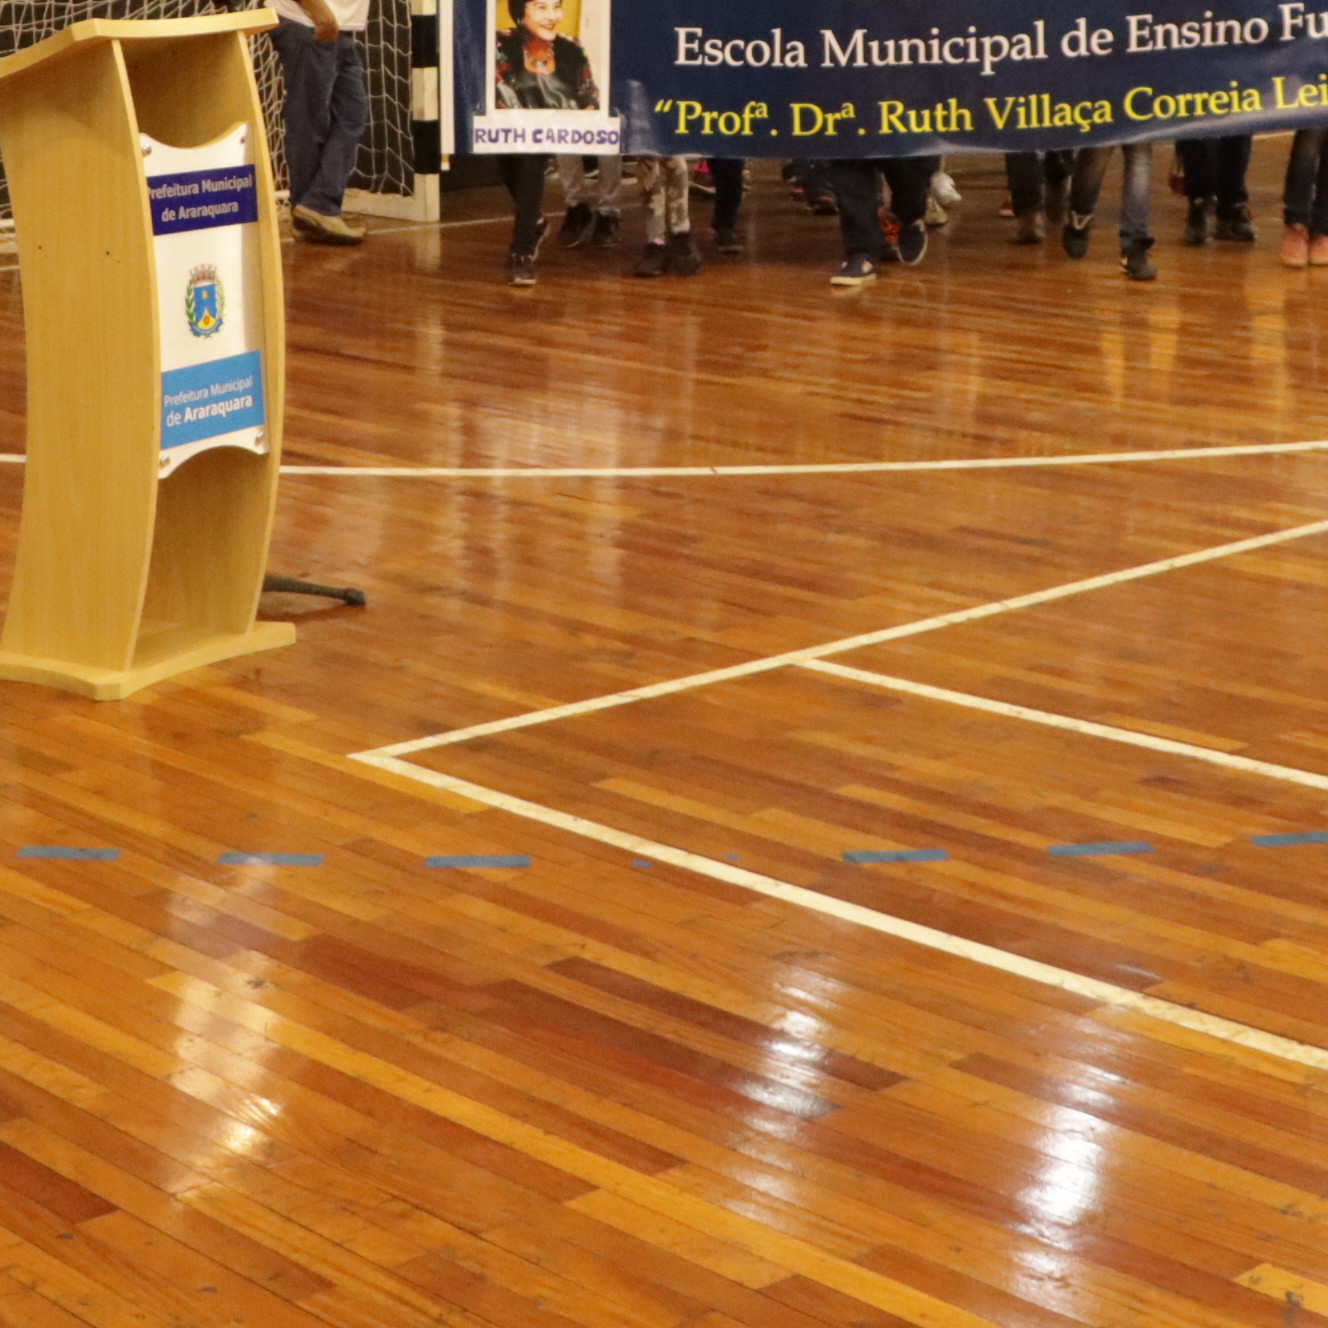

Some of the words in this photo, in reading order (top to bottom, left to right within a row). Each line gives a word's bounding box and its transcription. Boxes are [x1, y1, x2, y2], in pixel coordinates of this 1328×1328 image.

[674, 26, 808, 68] Escola
[820, 20, 1049, 76] Municipal
[1060, 17, 1115, 58] de
[1125, 10, 1270, 54] Ensino
[878, 98, 974, 135] Ruth
[983, 93, 1114, 133] Villaça
[1123, 80, 1263, 121] Correia
[474, 127, 527, 144] RUTH
[532, 128, 621, 145] CARDOSO
[201, 174, 253, 193] Municipal
[161, 207, 176, 222] de
[178, 201, 239, 219] Araraquara
[164, 388, 209, 407] Prefeitura
[210, 374, 253, 396] Municipal
[166, 411, 182, 427] de
[184, 395, 253, 424] Araraquara
